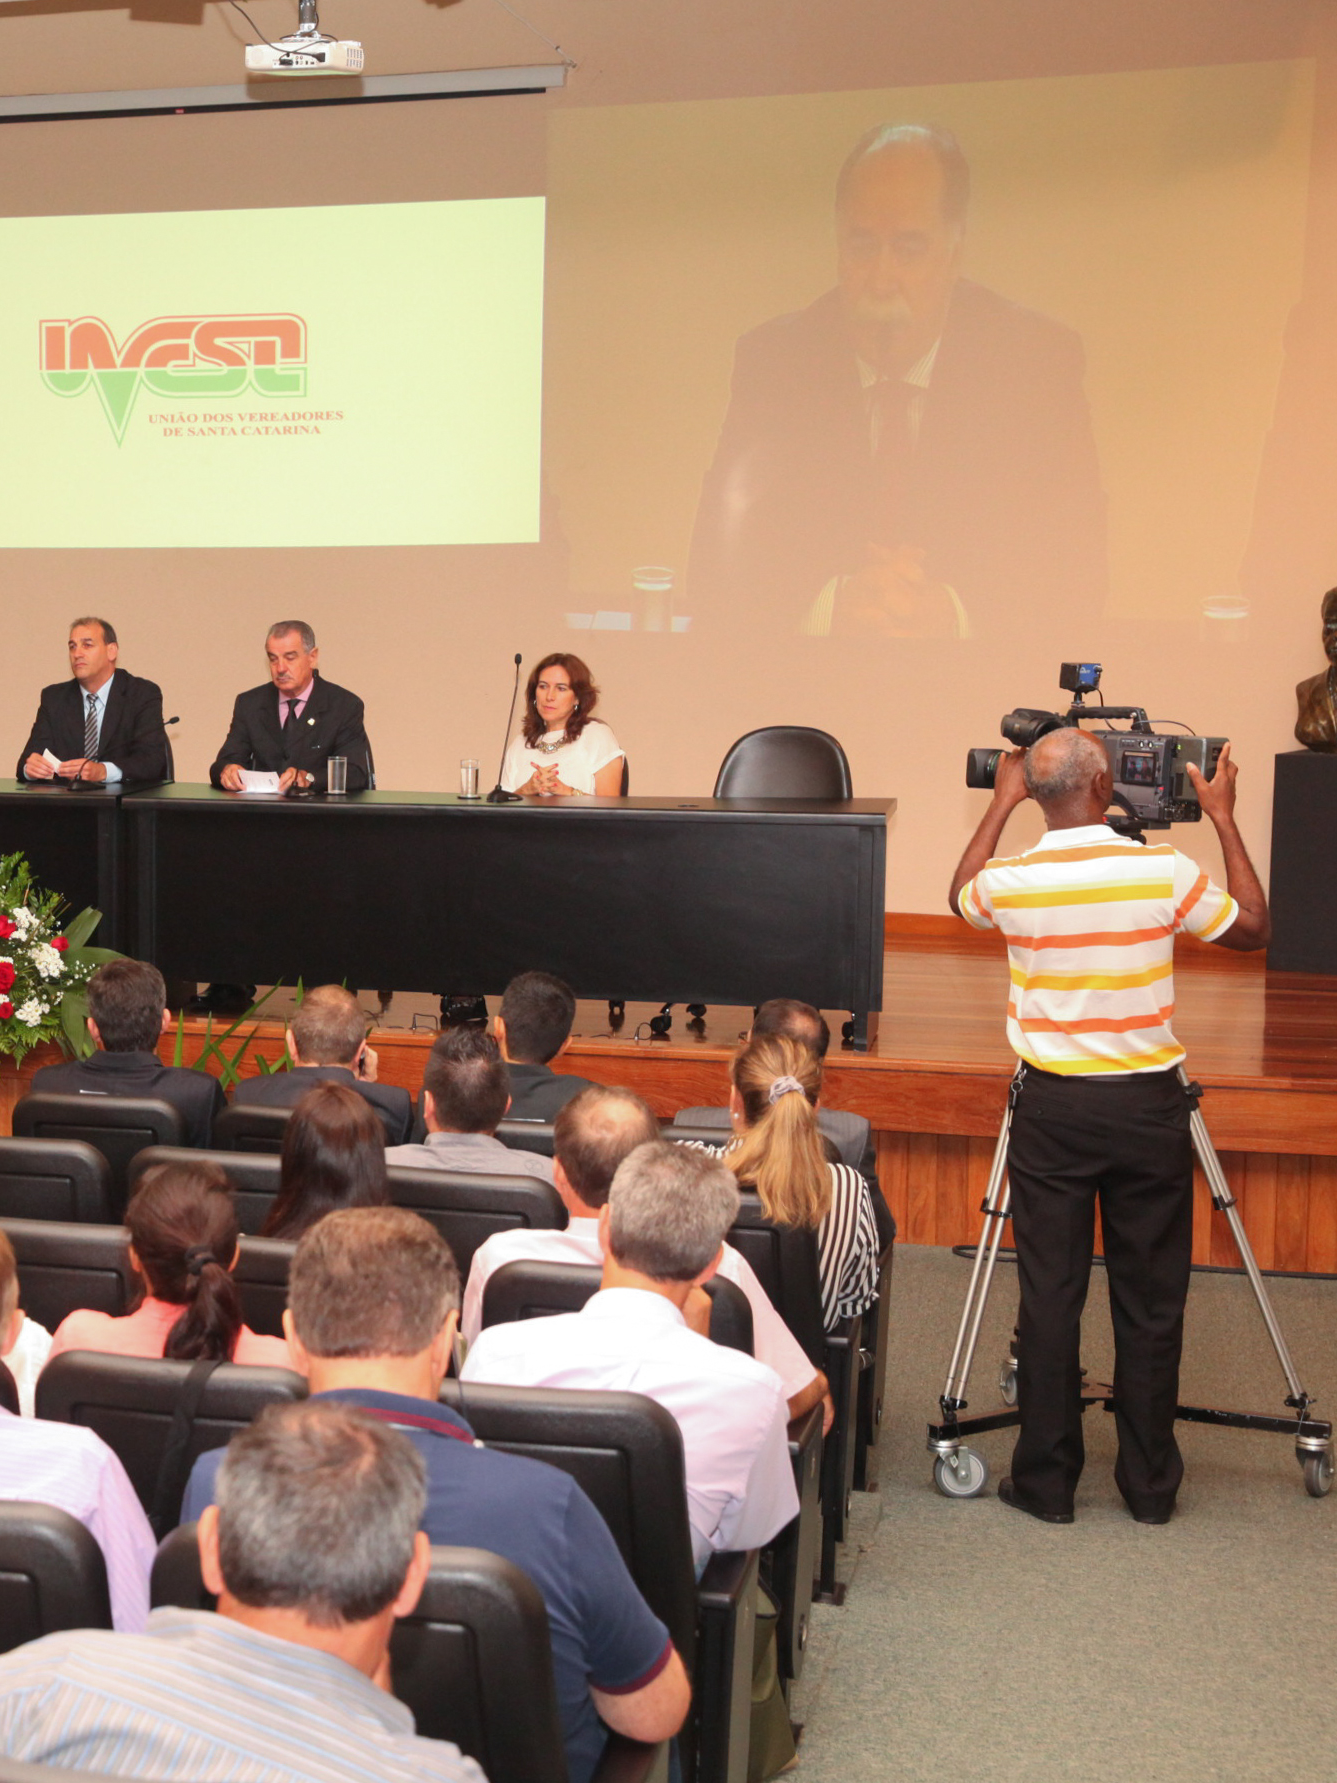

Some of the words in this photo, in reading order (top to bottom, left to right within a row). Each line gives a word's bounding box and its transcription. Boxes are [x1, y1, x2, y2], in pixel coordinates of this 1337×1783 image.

[148, 412, 198, 424] UNIÃO
[203, 413, 234, 423] DOS
[238, 411, 344, 423] VEREADORES
[163, 427, 183, 437] DE
[187, 426, 237, 437] SANTA
[240, 425, 321, 436] CATARINA
